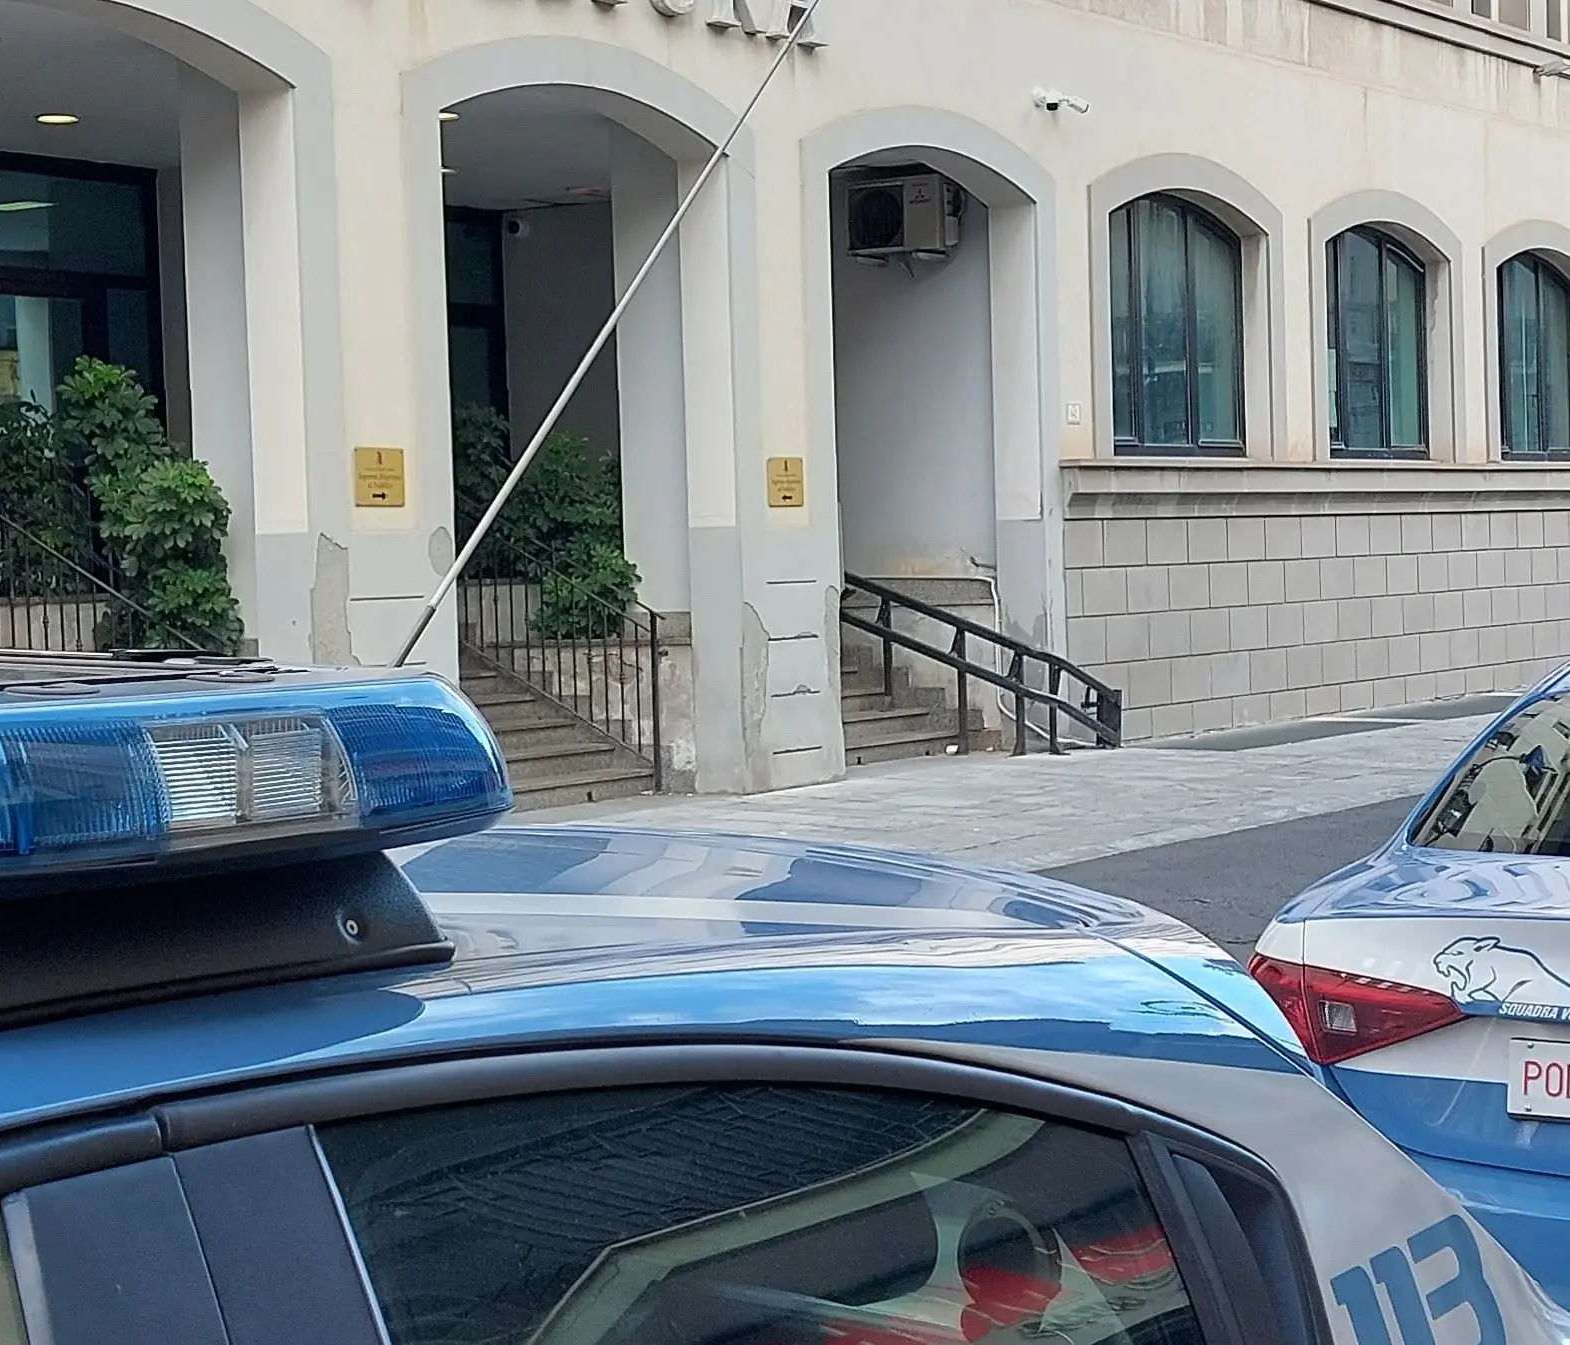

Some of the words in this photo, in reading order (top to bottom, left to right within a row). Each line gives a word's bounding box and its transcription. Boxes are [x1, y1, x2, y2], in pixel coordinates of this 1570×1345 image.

[1499, 1003, 1559, 1020] SQUADRA
[1524, 1060, 1570, 1099] PO
[1330, 1214, 1507, 1345] 113
